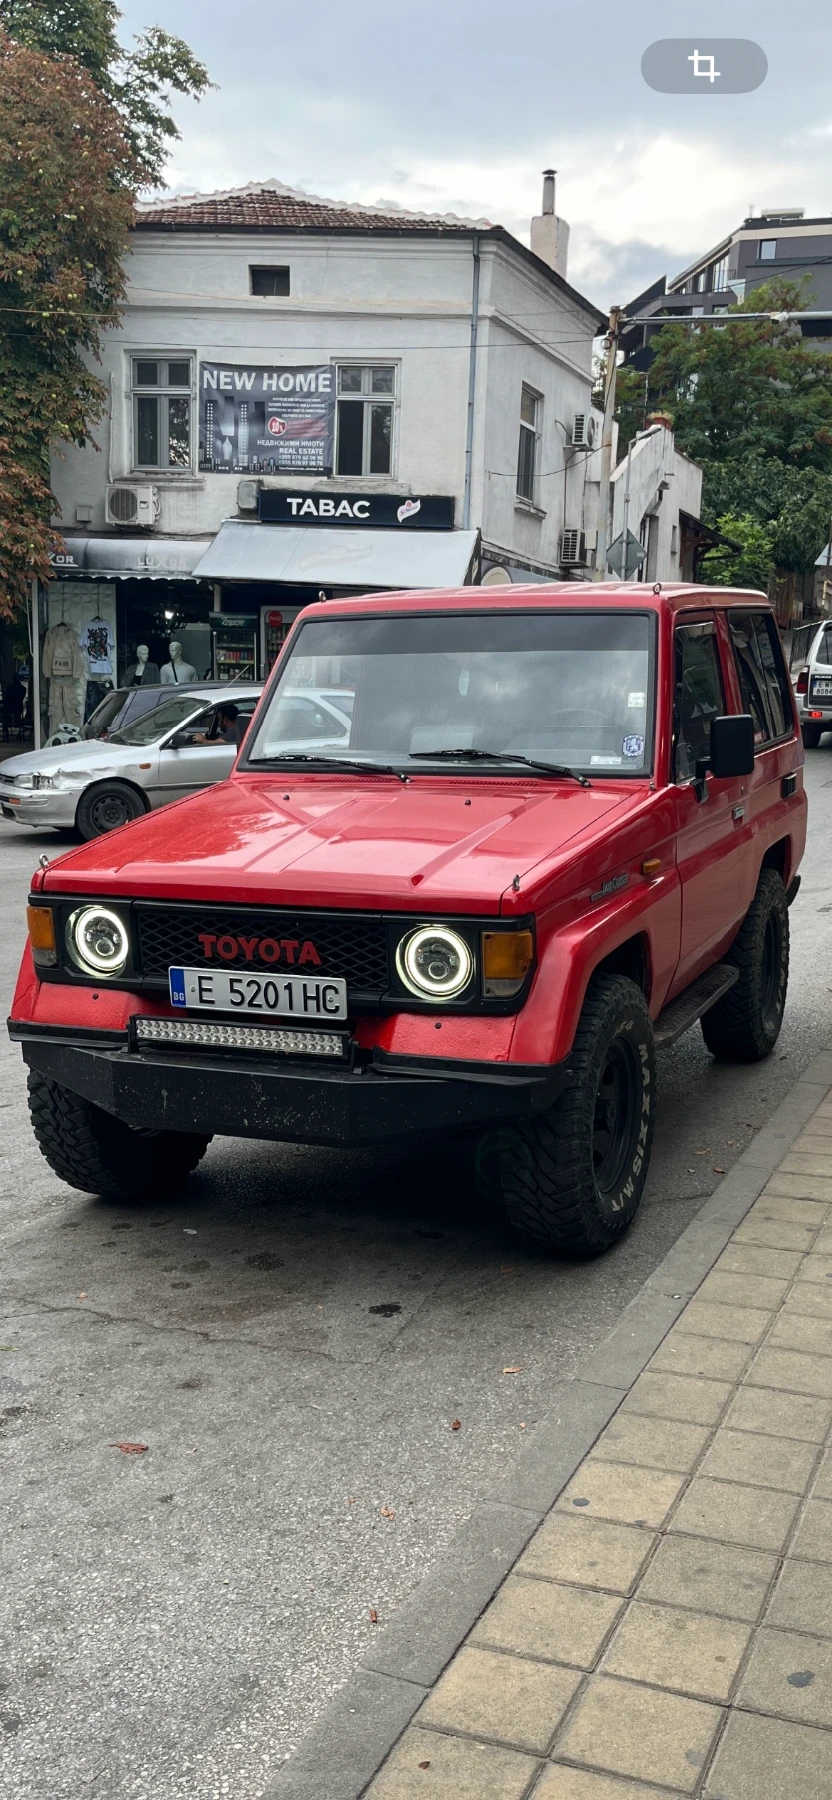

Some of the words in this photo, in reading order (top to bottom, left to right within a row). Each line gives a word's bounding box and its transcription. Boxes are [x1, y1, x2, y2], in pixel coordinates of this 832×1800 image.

[204, 370, 256, 390] NEW
[262, 373, 332, 392] HOME
[287, 498, 370, 518] TABAC
[198, 934, 322, 966] TOYOTA
[174, 992, 185, 1001] BG
[198, 976, 216, 1004] E
[634, 1044, 650, 1176] MAXXIS
[612, 1176, 634, 1212] M/T
